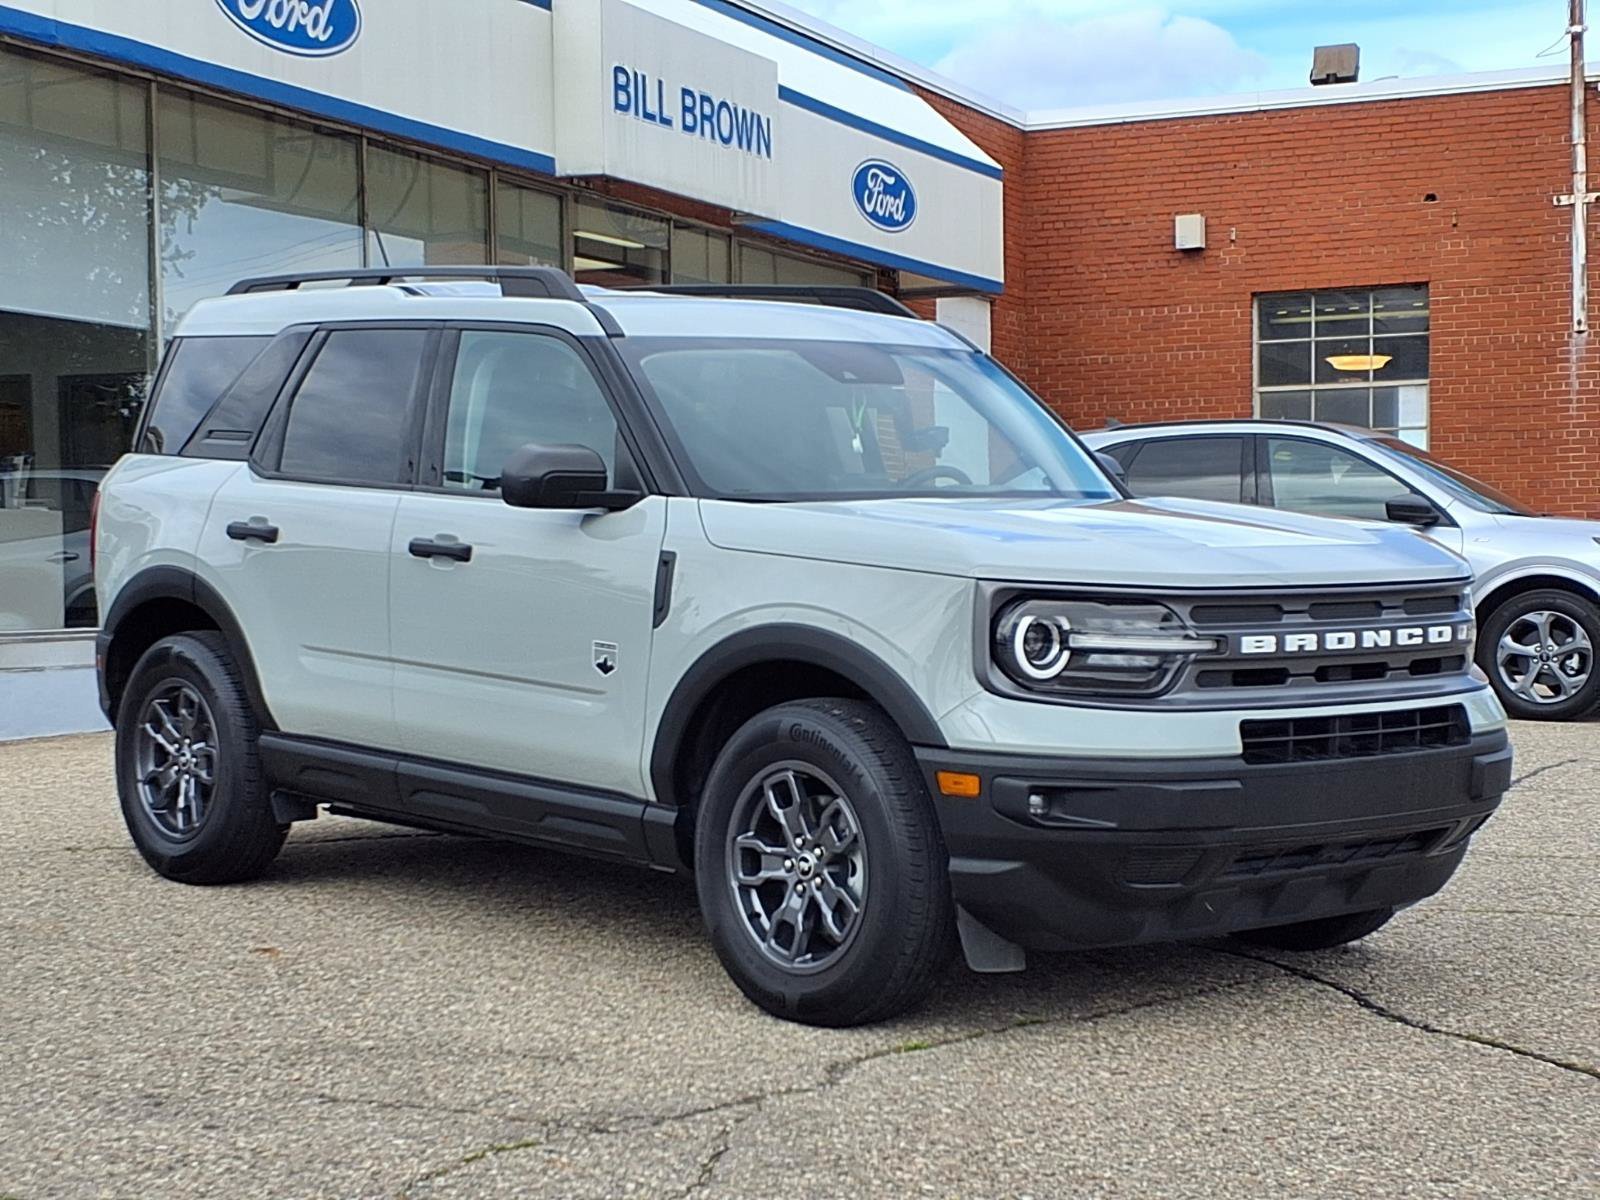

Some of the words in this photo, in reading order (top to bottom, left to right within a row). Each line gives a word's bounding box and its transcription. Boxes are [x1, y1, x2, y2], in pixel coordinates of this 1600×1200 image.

[613, 65, 673, 128] BILL
[681, 86, 771, 160] BROWN
[864, 168, 906, 222] Ford
[1240, 625, 1453, 654] BRONCO
[789, 722, 859, 777] Continental
